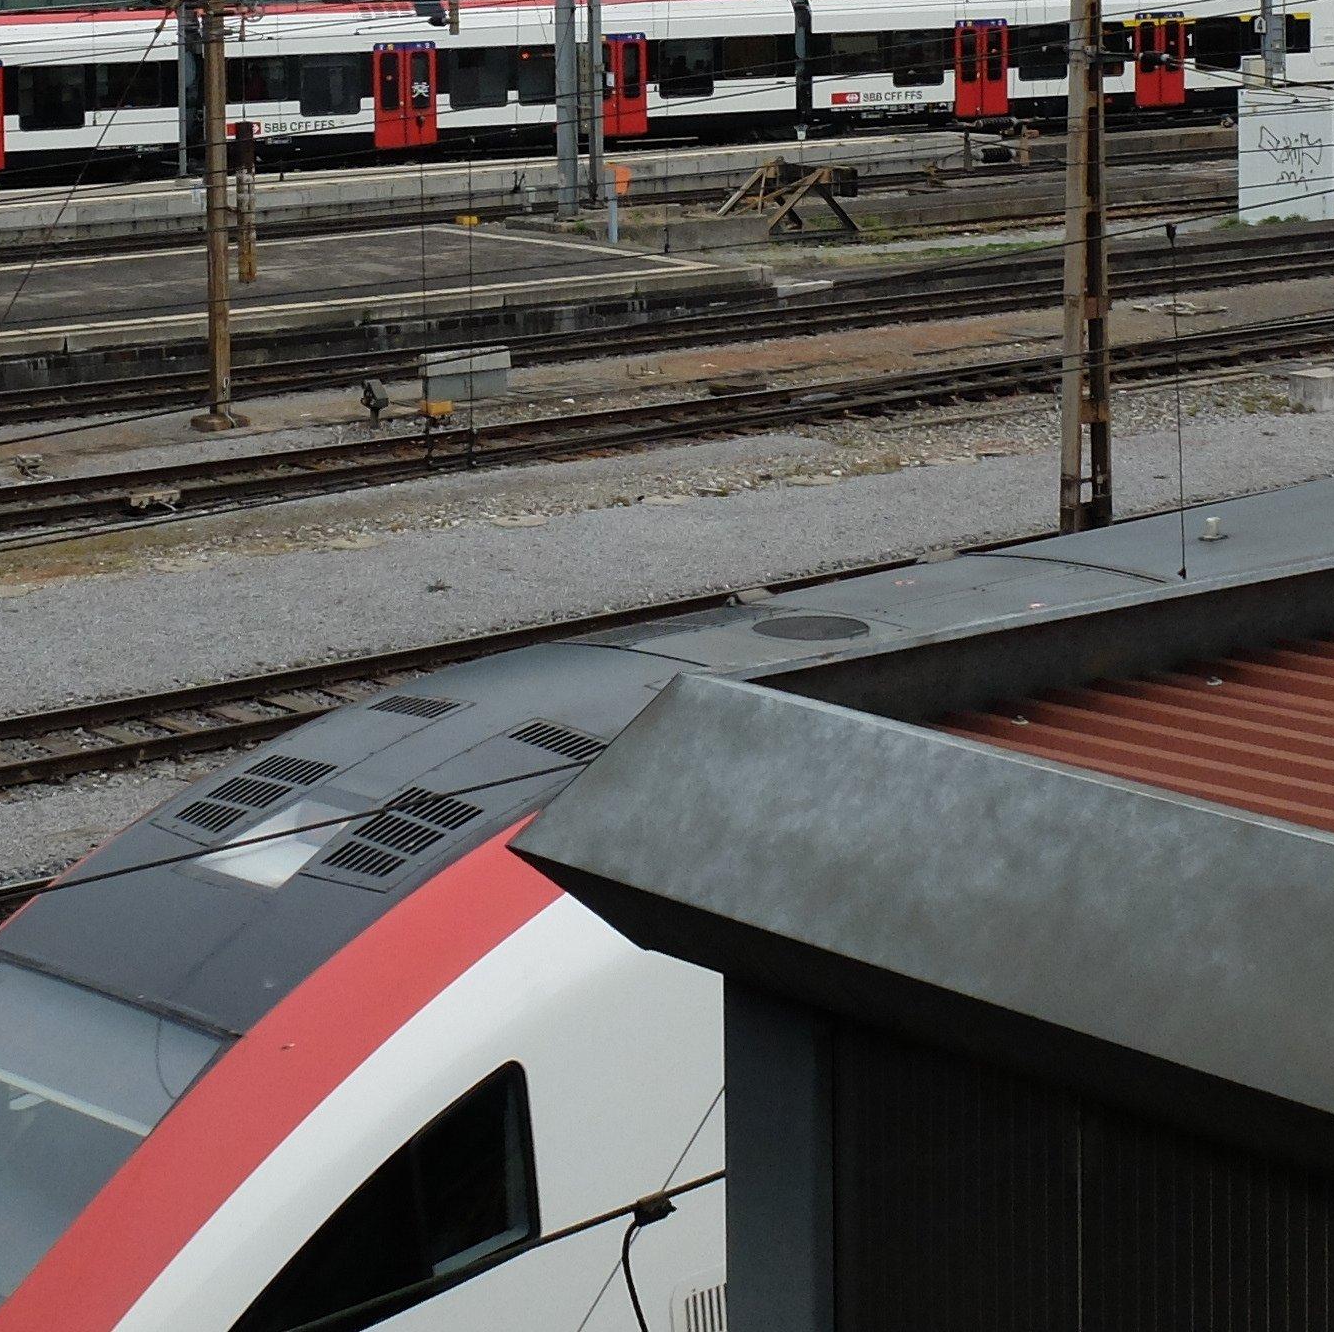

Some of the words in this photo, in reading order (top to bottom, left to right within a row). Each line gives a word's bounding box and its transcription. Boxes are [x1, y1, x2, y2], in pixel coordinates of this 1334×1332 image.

[863, 92, 882, 102] SBB
[884, 92, 902, 101] CFF
[905, 91, 923, 100] FFS
[264, 122, 287, 133] SBB
[290, 121, 312, 131] CFF
[314, 120, 335, 130] FFS
